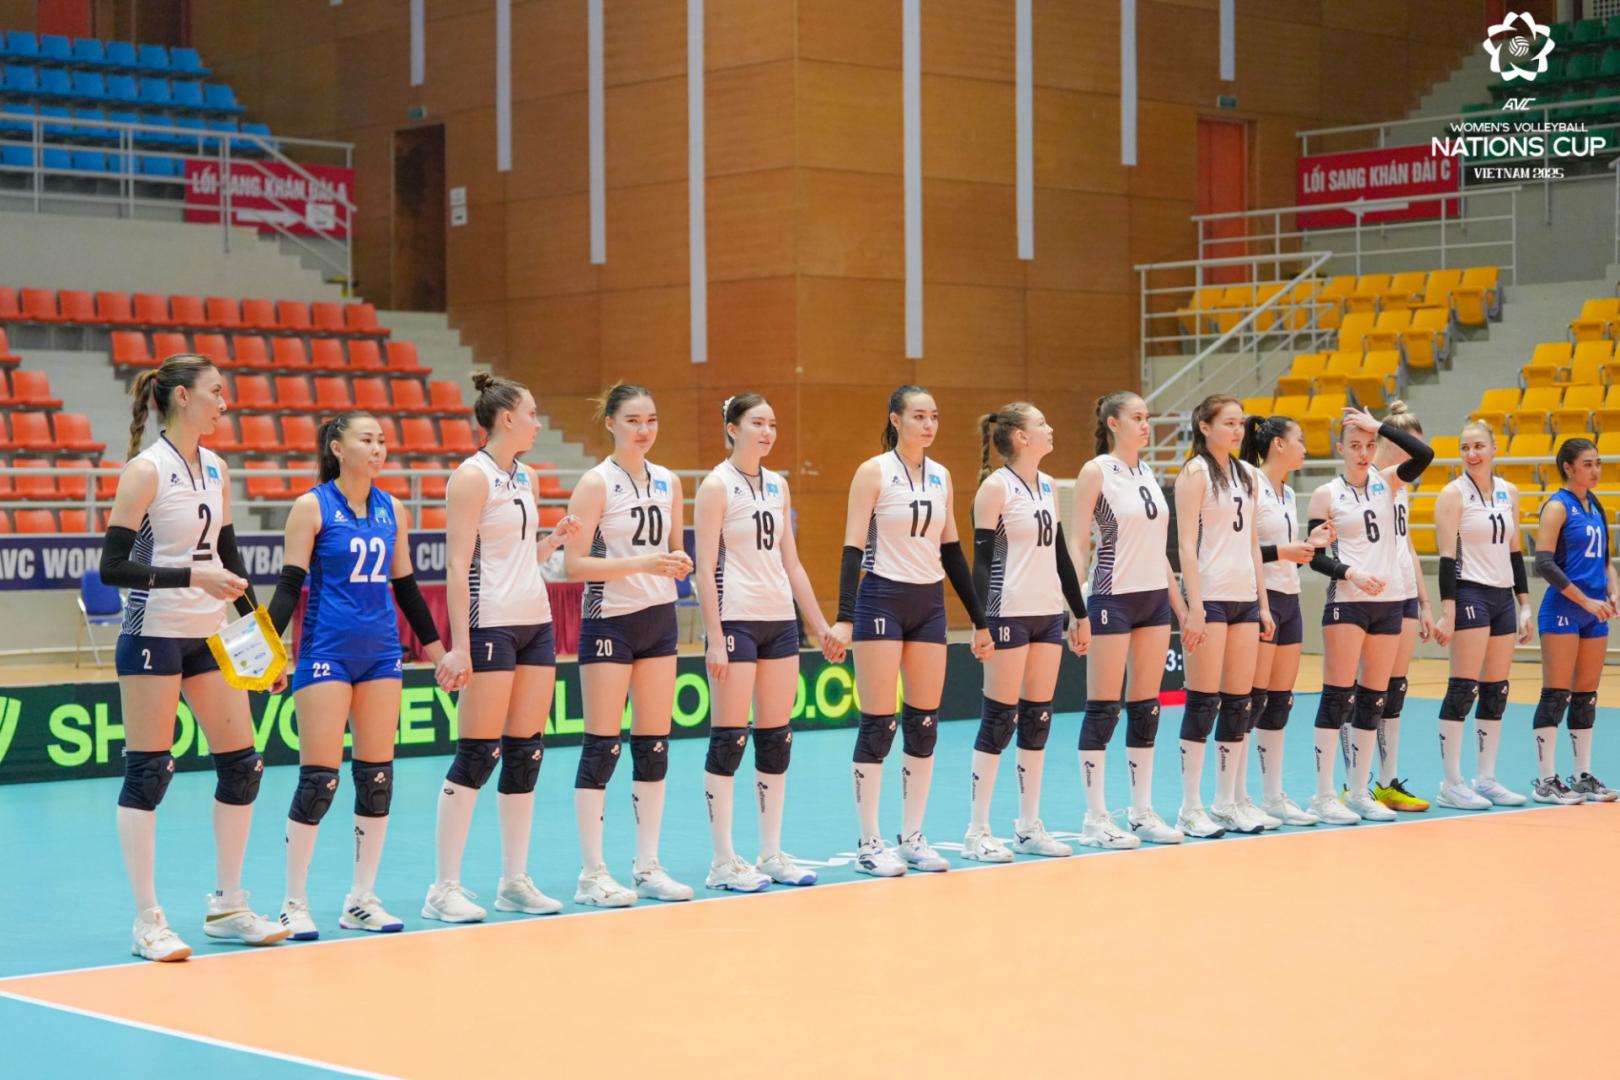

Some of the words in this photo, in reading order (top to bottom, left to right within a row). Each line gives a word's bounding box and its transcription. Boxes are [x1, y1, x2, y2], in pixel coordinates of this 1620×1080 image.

[1303, 164, 1325, 194] LỐI
[1328, 167, 1366, 192] SANG
[1369, 160, 1408, 188] KHÁN
[1412, 156, 1437, 184] ĐÀI
[1440, 158, 1451, 181] C
[514, 498, 527, 541] 7
[909, 500, 932, 537] 17
[1139, 485, 1158, 520] 8
[1232, 497, 1244, 532] 3
[196, 503, 212, 550] 2
[631, 505, 663, 546] 20
[752, 510, 775, 550] 19
[1034, 509, 1054, 547] 18
[1284, 512, 1292, 542] 1
[1363, 509, 1380, 543] 6
[1489, 513, 1506, 544] 11
[1584, 524, 1603, 558] 21
[0, 548, 36, 580] VC
[416, 542, 447, 572] CU
[350, 536, 387, 583] 22
[874, 617, 886, 635] 17
[1100, 609, 1109, 625] 8
[1333, 607, 1340, 621] 6
[1465, 605, 1476, 620] 11
[485, 641, 494, 661] 7
[595, 638, 613, 657] 20
[998, 626, 1011, 642] 18
[142, 648, 153, 670] 2
[312, 662, 332, 678] 22
